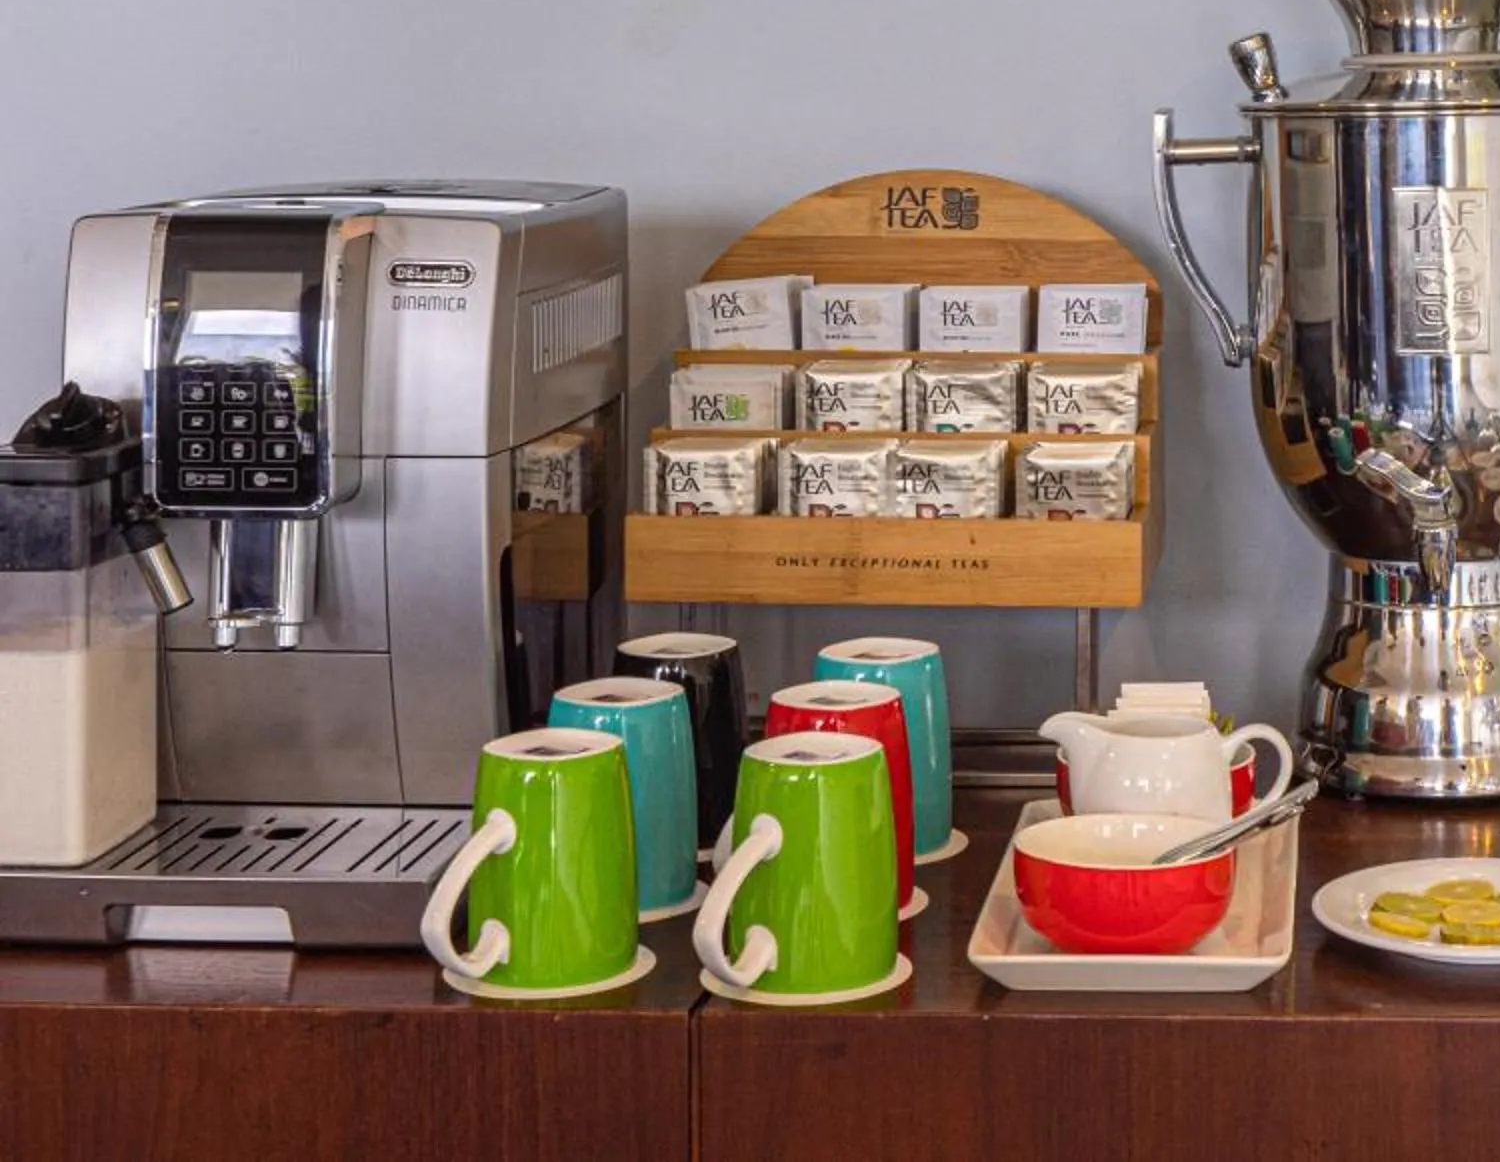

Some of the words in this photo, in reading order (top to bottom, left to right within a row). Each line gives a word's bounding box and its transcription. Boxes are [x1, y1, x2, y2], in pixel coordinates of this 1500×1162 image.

[880, 186, 938, 211] JAF
[887, 207, 939, 229] TEA
[392, 294, 468, 312] DINAMICA
[708, 291, 745, 311] JAF
[820, 299, 857, 315] JAF
[940, 300, 974, 315] JAF
[1062, 296, 1096, 313] JAF
[710, 305, 746, 320] TEA
[824, 311, 858, 325] TEA
[942, 312, 976, 327] TEA
[1064, 310, 1098, 325] TEA
[688, 394, 725, 411] JAF
[1044, 398, 1083, 415] TEA
[690, 406, 726, 422] TEA
[1032, 484, 1074, 501] TEA
[775, 556, 820, 567] ONLY
[829, 556, 942, 569] EXCEPTIONAL
[952, 558, 990, 570] TEAS
